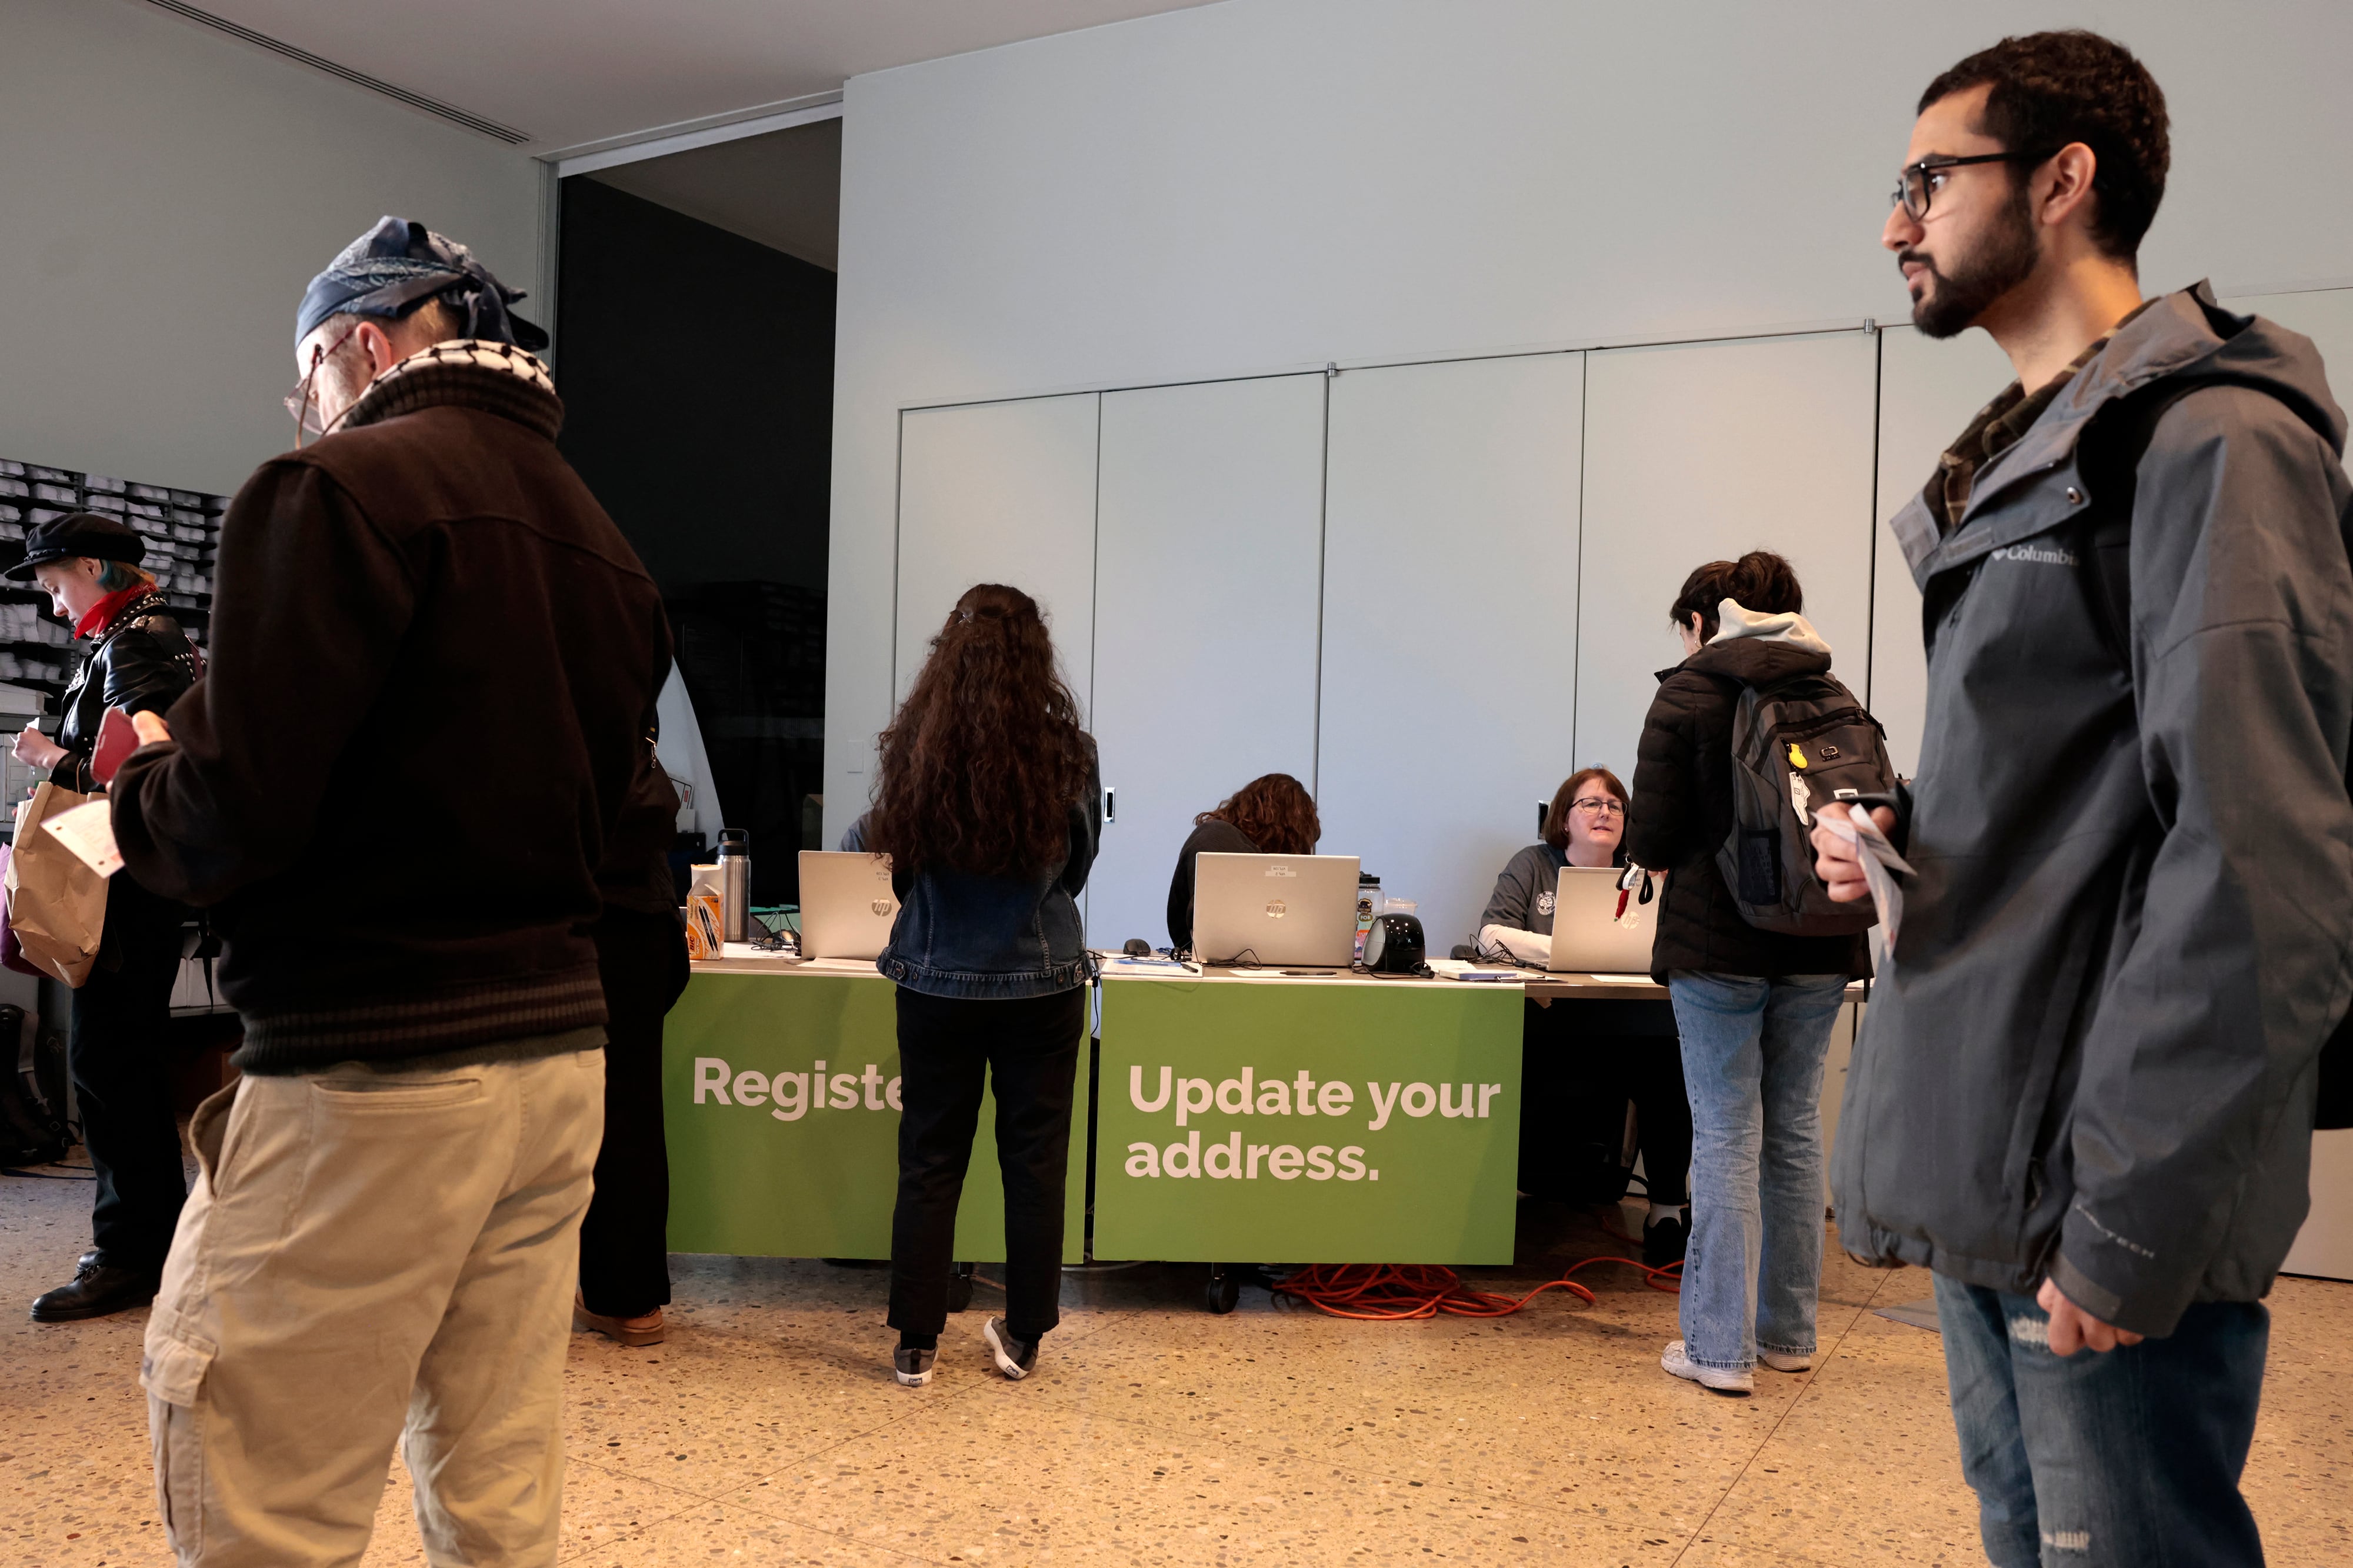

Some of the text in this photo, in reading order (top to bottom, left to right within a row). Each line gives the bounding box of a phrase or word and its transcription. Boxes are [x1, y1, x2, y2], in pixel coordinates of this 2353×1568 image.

[873, 899, 891, 916] hp
[1267, 899, 1285, 918] hp
[1130, 1066, 1501, 1131] Update your
[1125, 1130, 1379, 1181] address.
